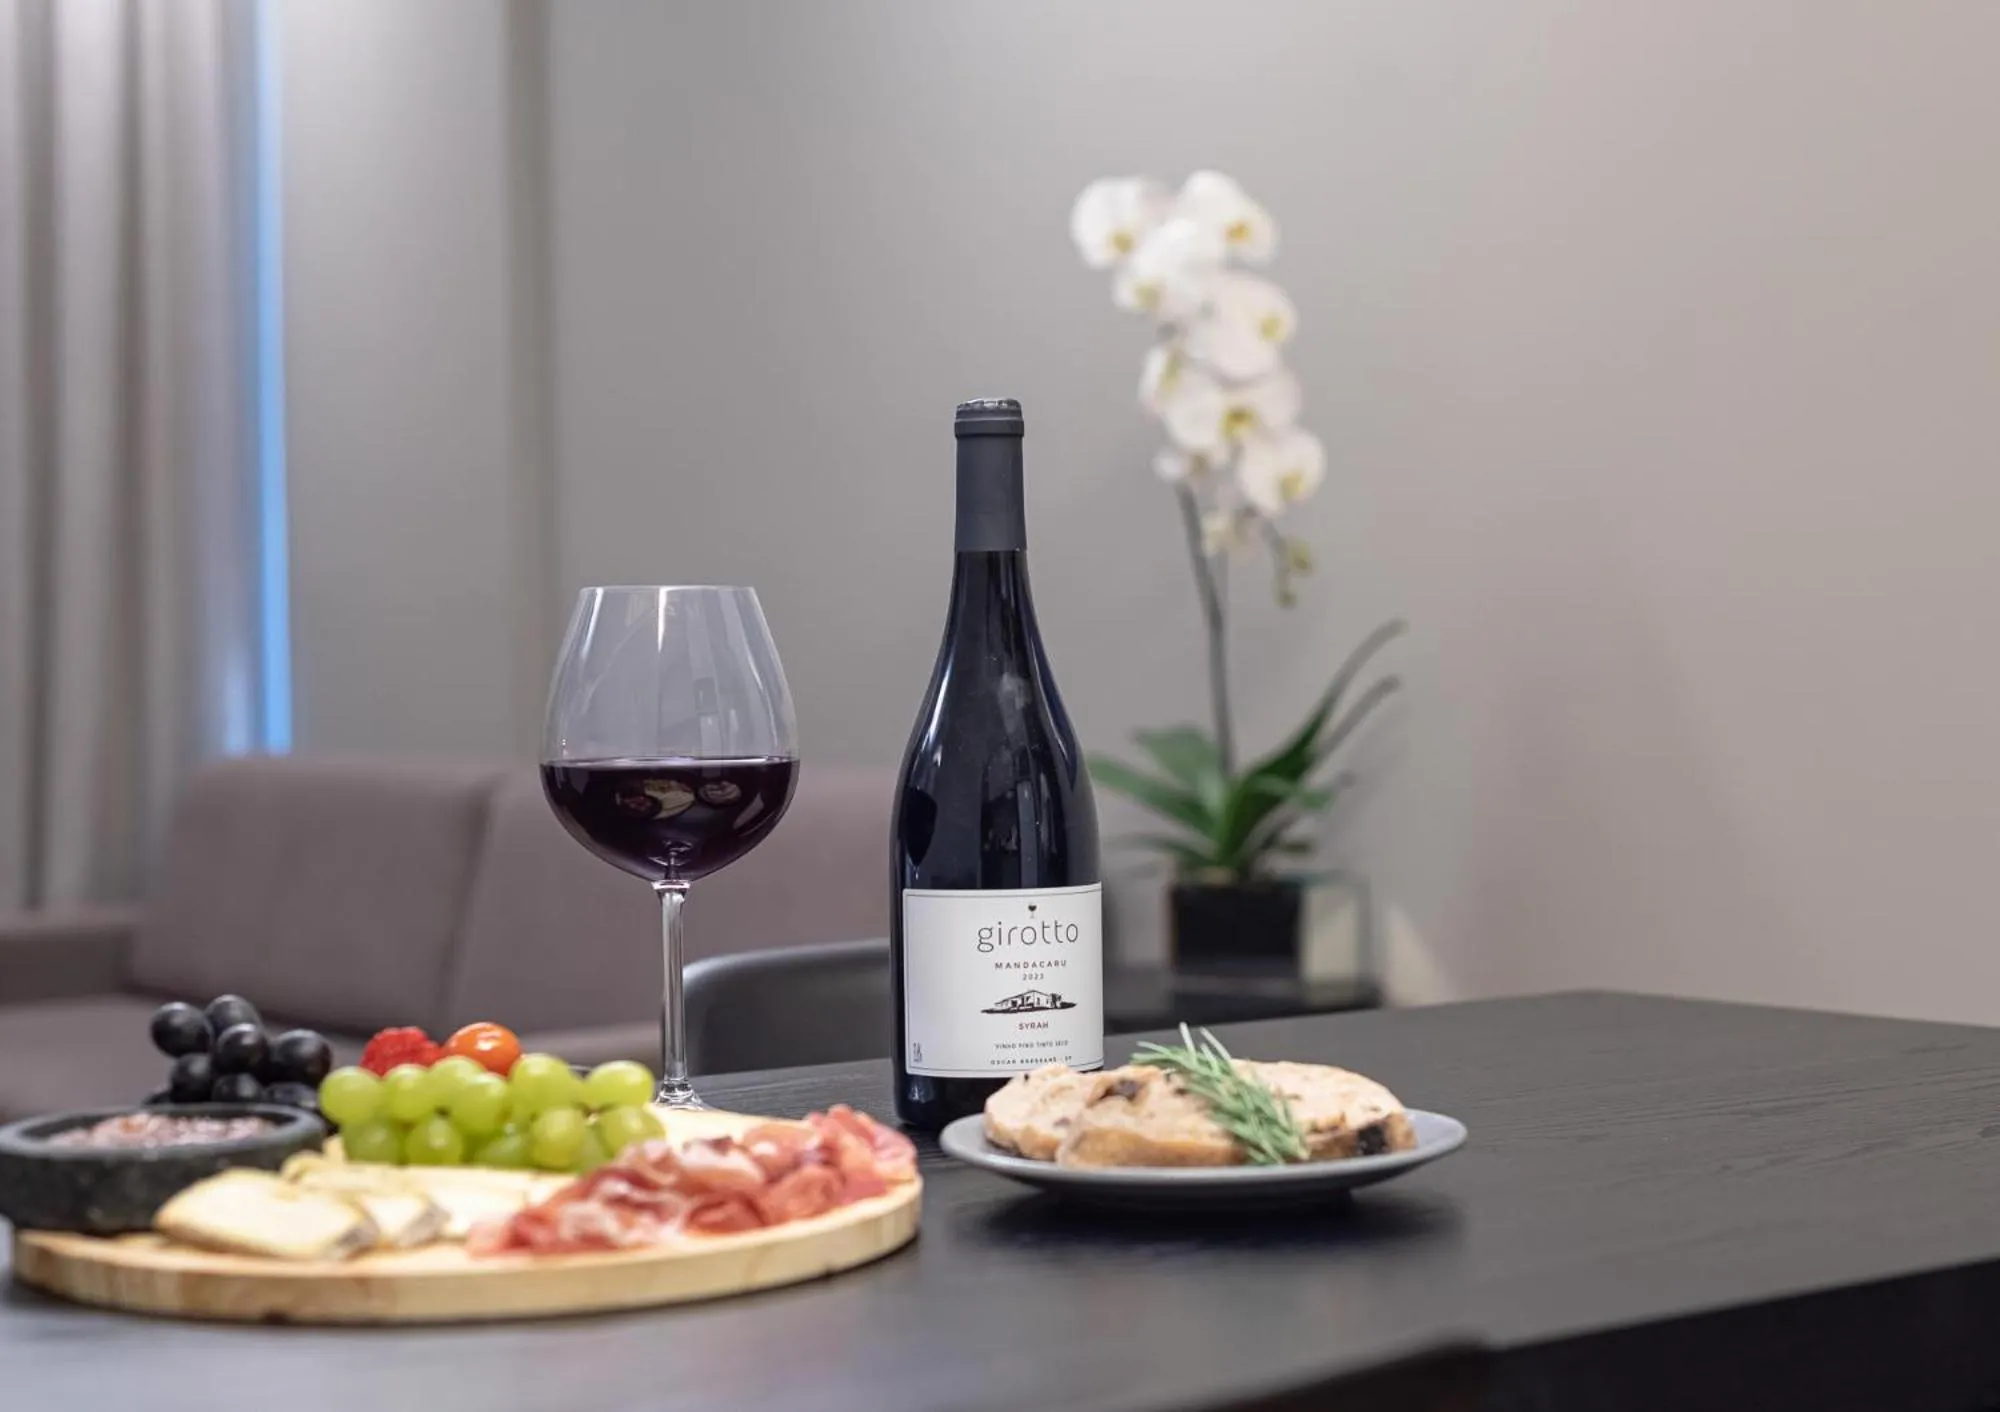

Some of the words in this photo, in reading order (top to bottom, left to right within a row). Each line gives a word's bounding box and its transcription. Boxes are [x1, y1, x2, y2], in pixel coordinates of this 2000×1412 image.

[977, 920, 1078, 953] girotto
[994, 960, 1067, 970] MANDACARU
[1018, 1021, 1049, 1030] SYRAH
